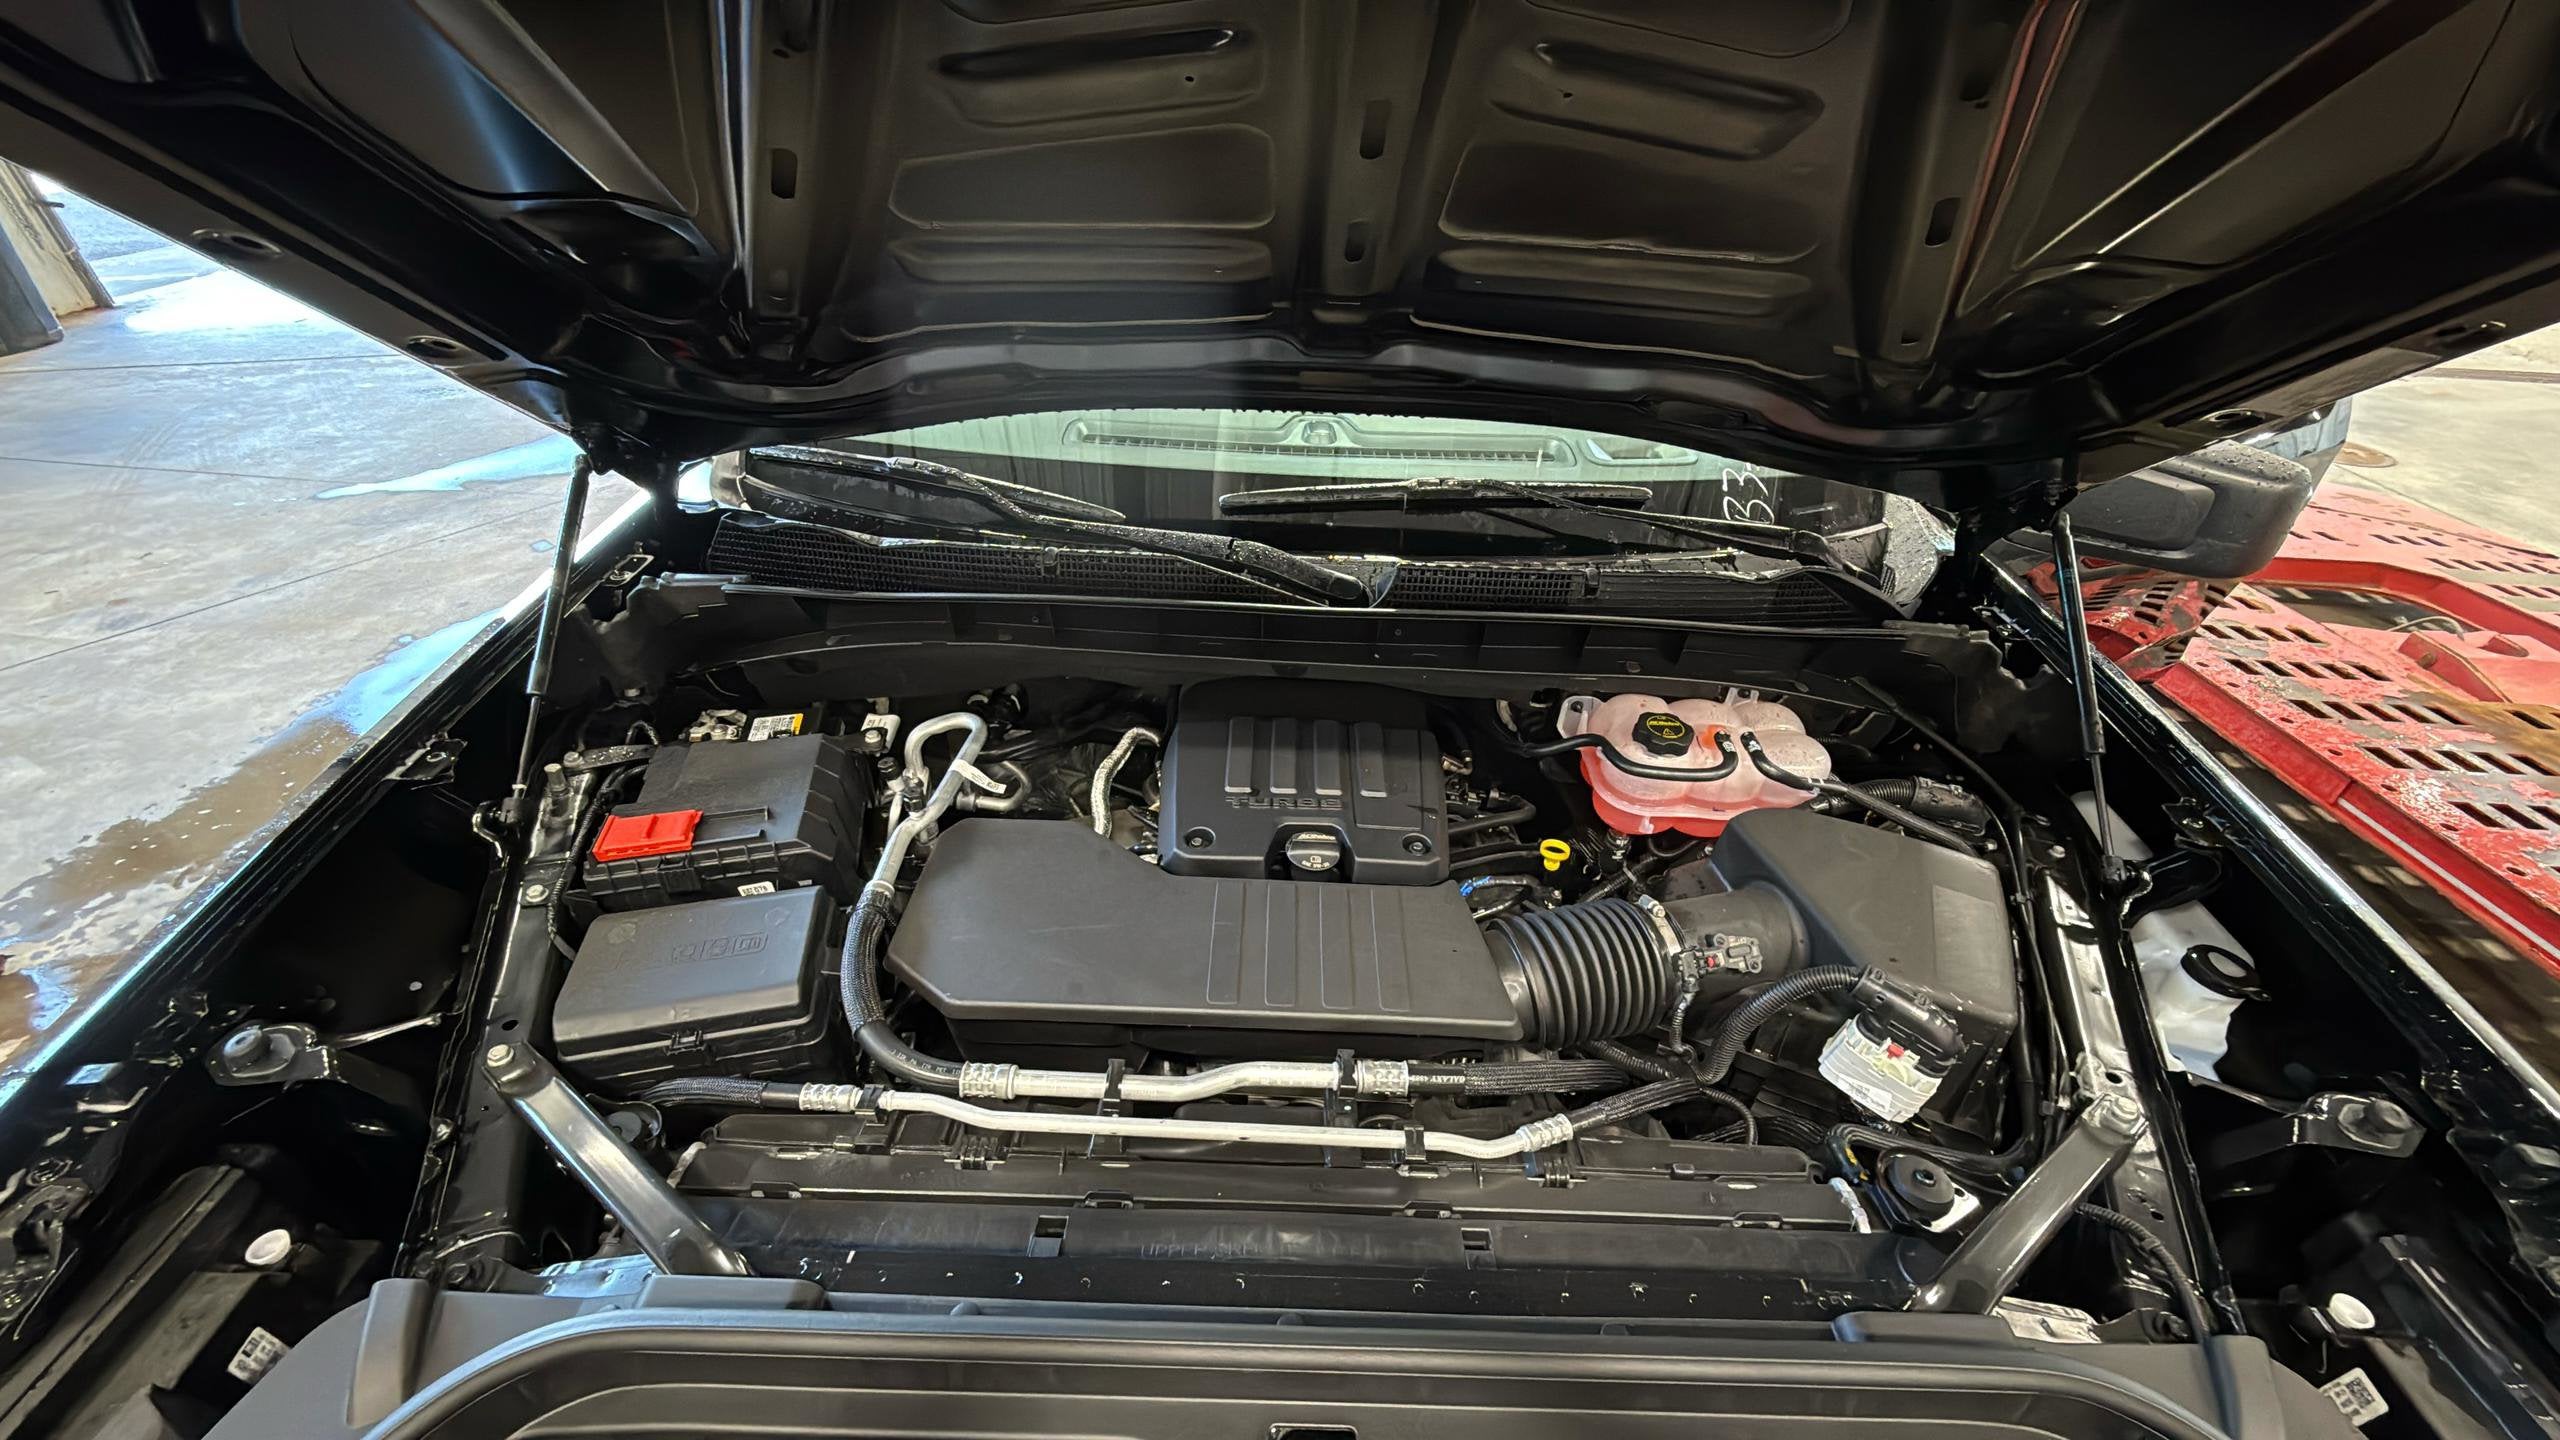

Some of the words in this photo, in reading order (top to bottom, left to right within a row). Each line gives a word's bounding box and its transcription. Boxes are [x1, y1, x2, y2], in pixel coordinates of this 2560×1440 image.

[1722, 462, 1775, 525] B3
[1225, 796, 1343, 811] TURBO
[1430, 1075, 1466, 1084] GALAXY
